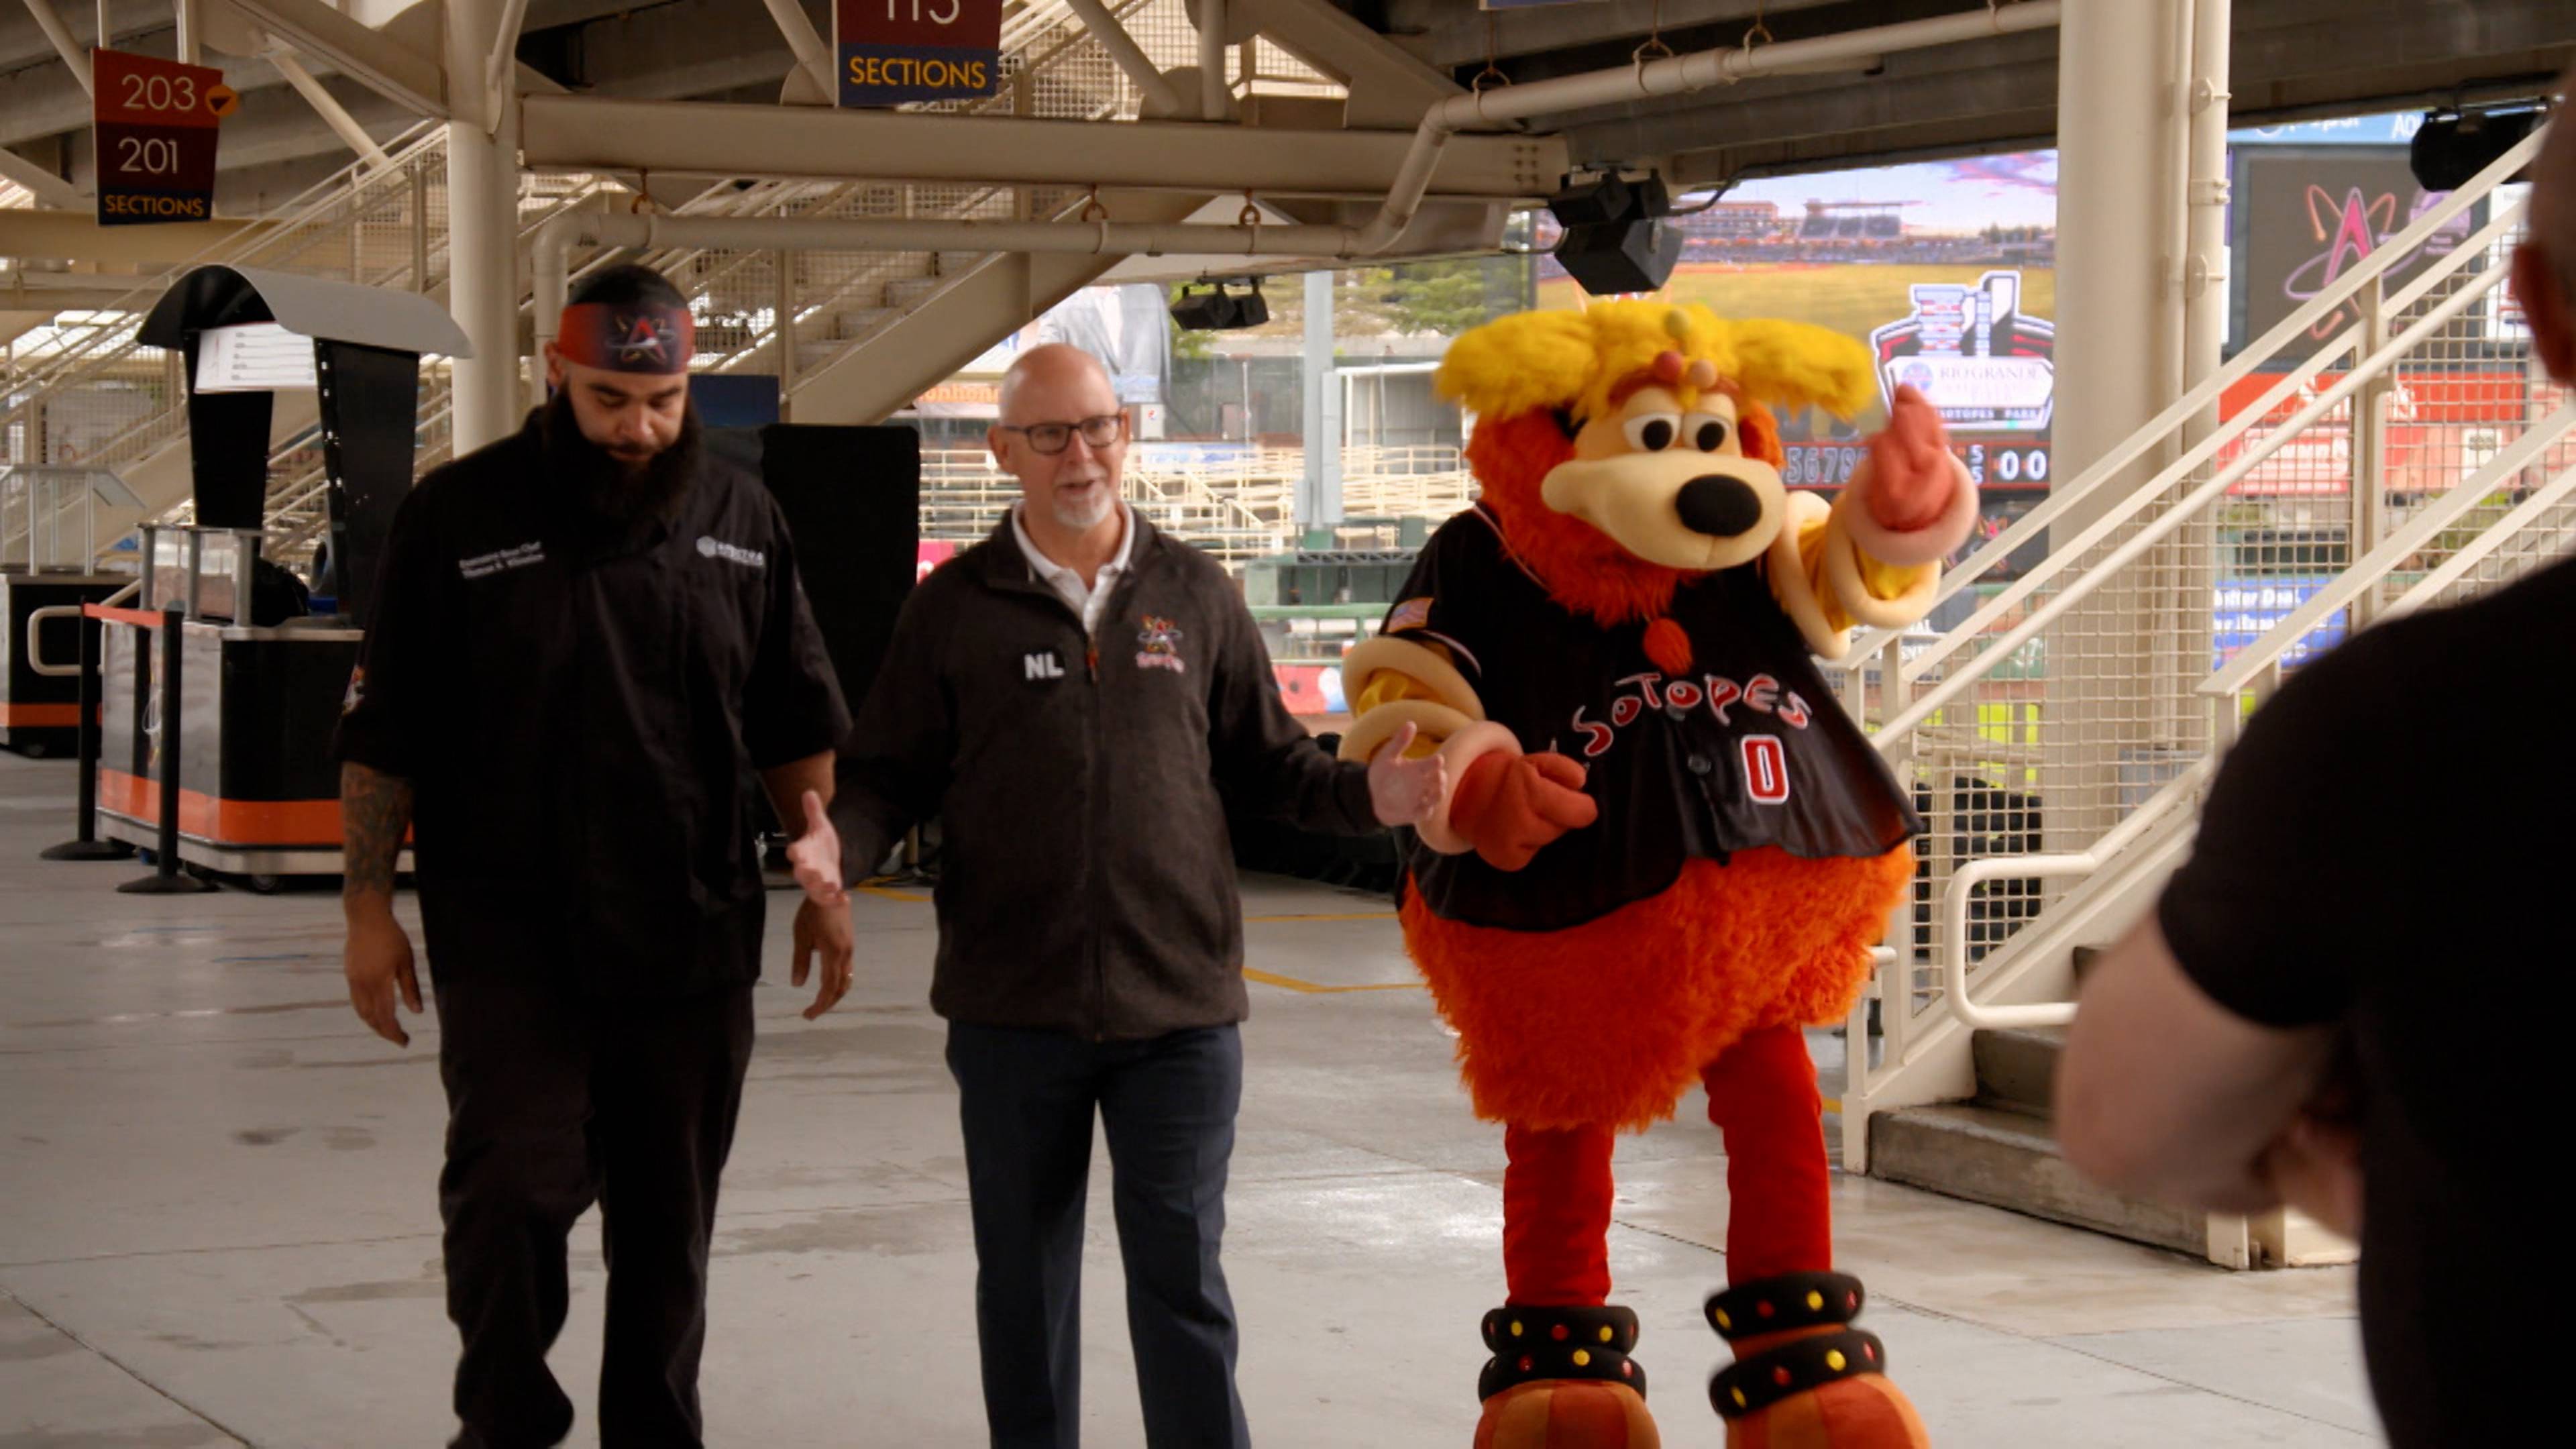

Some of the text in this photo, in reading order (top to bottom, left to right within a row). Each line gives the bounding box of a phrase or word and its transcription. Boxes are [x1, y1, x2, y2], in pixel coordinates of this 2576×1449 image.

[849, 56, 987, 89] SECTIONS
[121, 74, 197, 111] 203
[118, 136, 178, 174] 201
[105, 194, 205, 217] SECTIONS
[1024, 652, 1065, 680] NL
[1551, 672, 1813, 758] SOTOPES
[1741, 734, 1790, 804] 0
